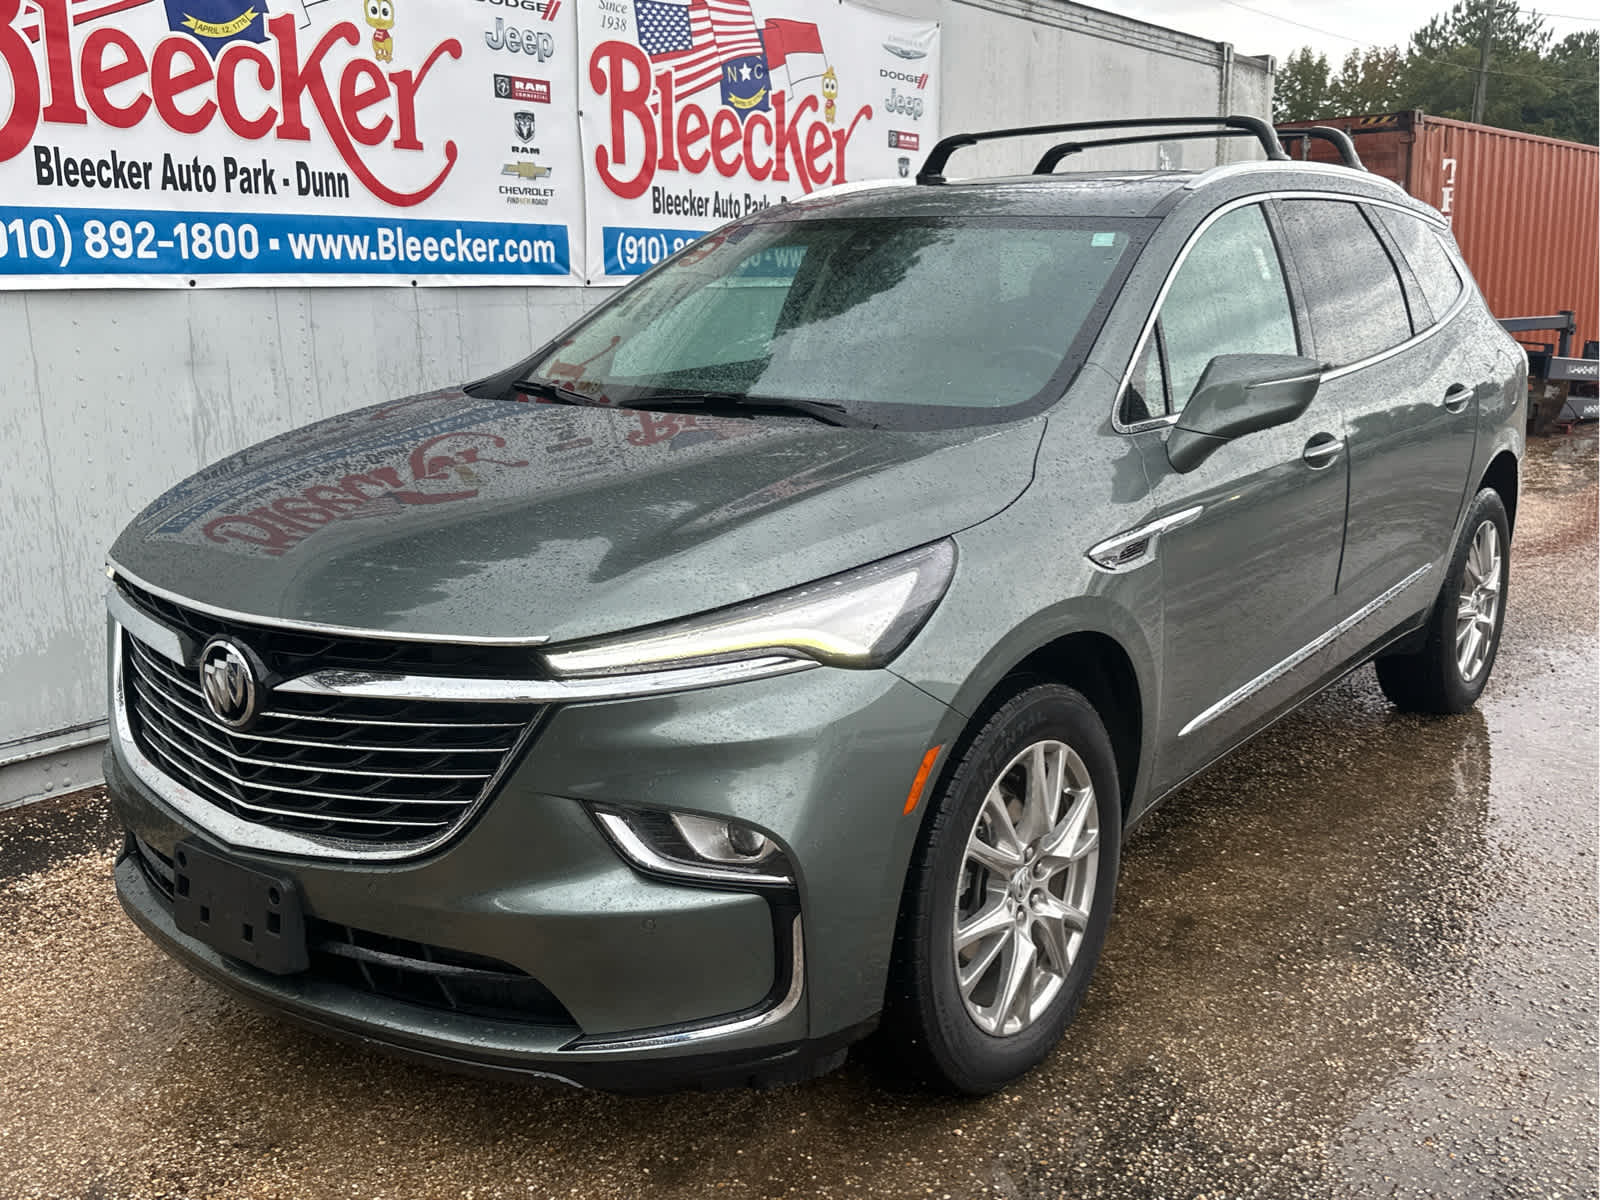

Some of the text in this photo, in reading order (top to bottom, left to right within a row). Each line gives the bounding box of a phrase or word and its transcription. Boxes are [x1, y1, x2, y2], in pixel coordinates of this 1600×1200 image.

[598, 0, 628, 14] Since
[197, 23, 220, 35] APRIL
[602, 15, 627, 31] 1938
[485, 16, 554, 63] Jeep
[727, 63, 764, 83] N C
[880, 69, 921, 84] DODGE
[514, 80, 547, 92] RAM
[885, 88, 924, 120] Jeep
[590, 41, 873, 199] Bleecker
[511, 146, 540, 155] RAM
[33, 145, 350, 198] Bleecker Auto Park Dunn
[498, 185, 555, 197] CHEVROLET
[652, 185, 710, 217] Bleecker
[713, 190, 741, 219] Auto
[83, 219, 259, 260] 892-1800
[287, 227, 556, 264] www.Bleecker.com
[616, 232, 668, 271] (910)
